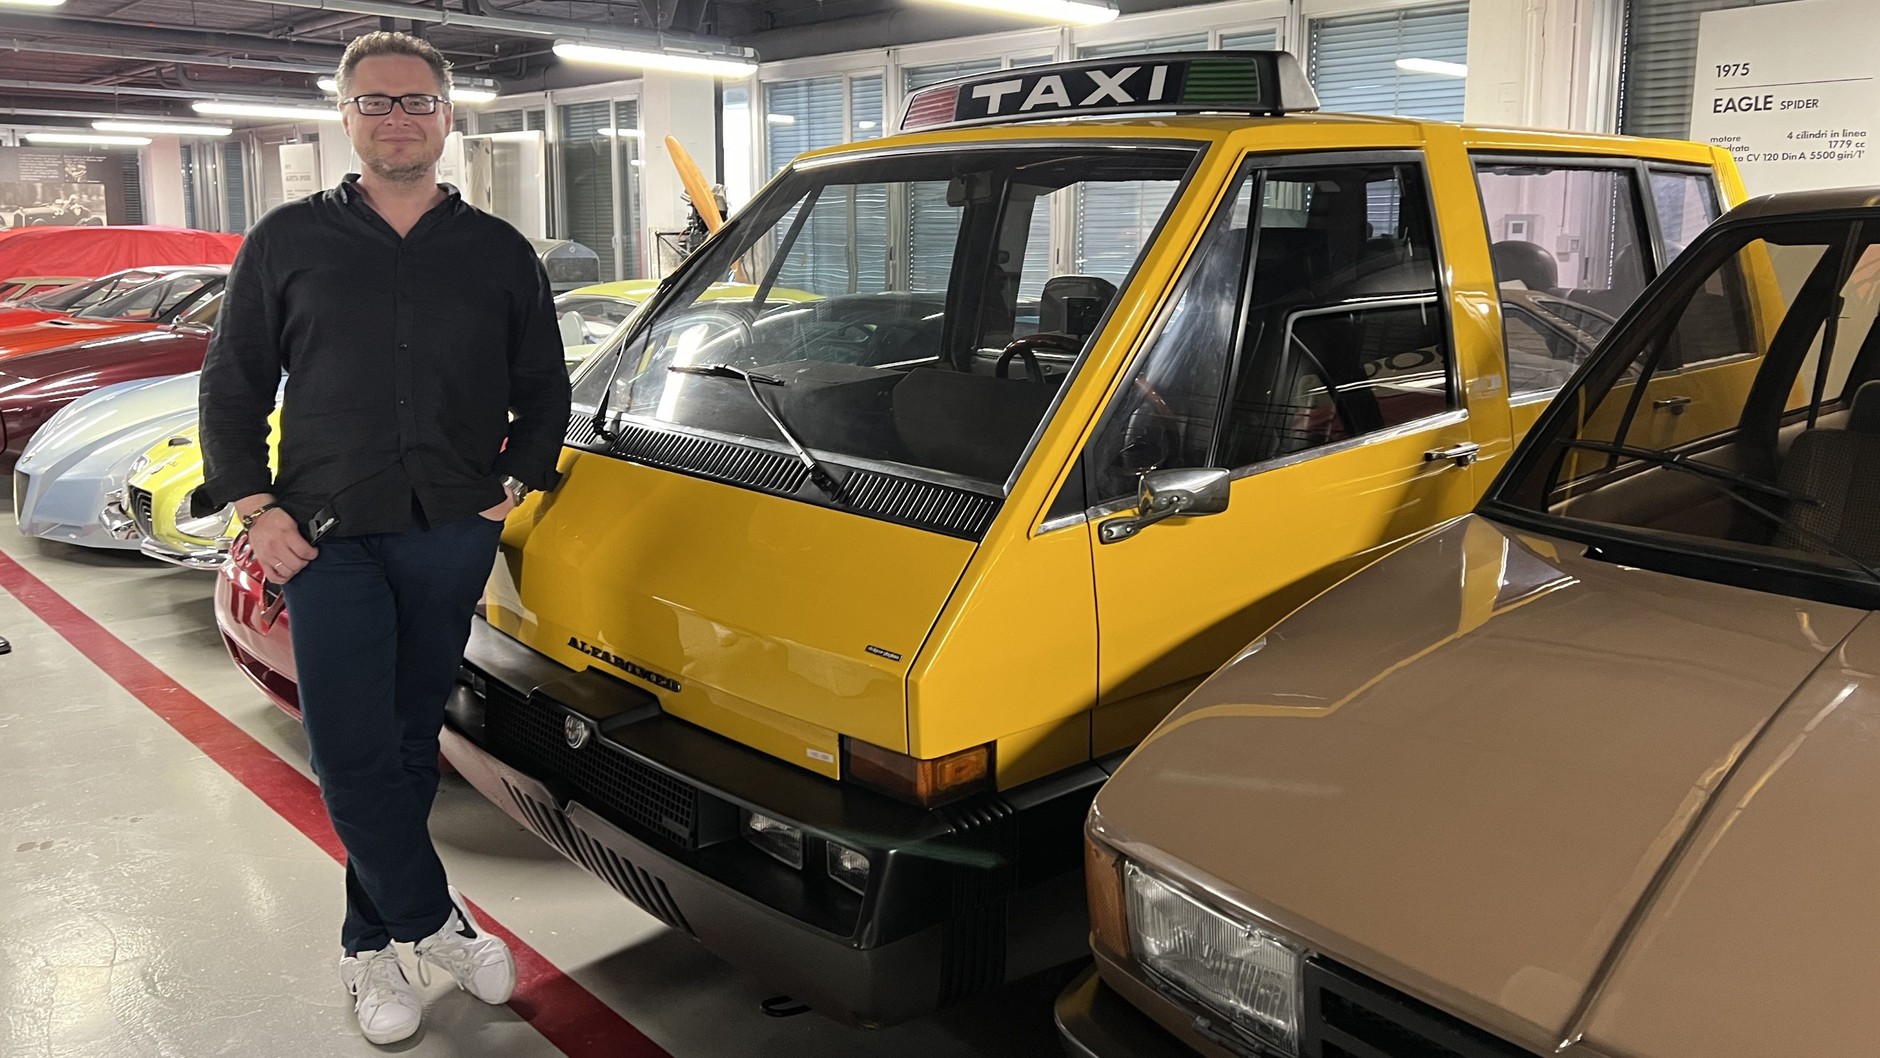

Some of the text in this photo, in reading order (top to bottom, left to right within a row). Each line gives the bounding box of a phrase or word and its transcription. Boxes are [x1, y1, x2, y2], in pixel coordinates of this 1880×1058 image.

[1715, 63, 1750, 78] 1975
[971, 65, 1168, 114] TAXI
[1712, 95, 1819, 114] EAGLE SPIDER
[1786, 128, 1867, 140] 4 cilindri in linea
[1828, 139, 1852, 149] 1779
[1746, 153, 1761, 162] CV
[1762, 153, 1779, 162] 120
[1809, 151, 1836, 160] 5500
